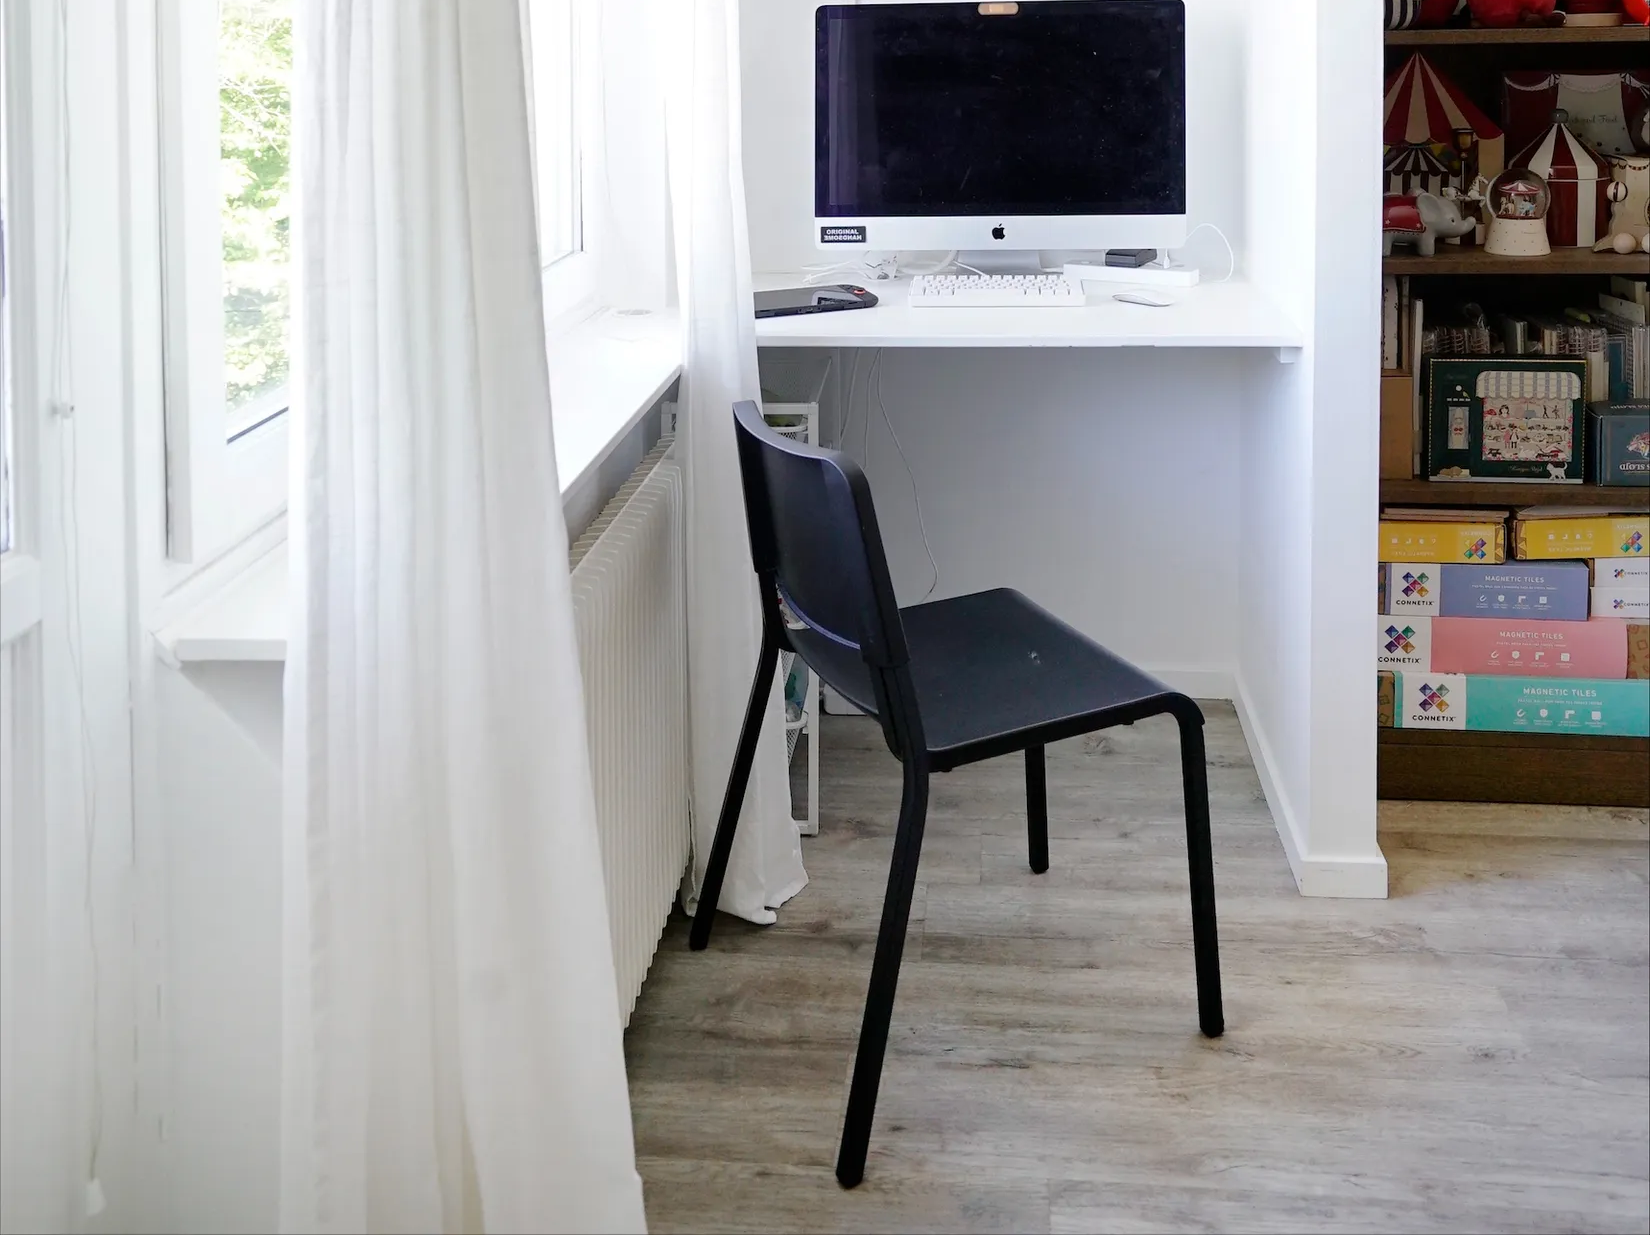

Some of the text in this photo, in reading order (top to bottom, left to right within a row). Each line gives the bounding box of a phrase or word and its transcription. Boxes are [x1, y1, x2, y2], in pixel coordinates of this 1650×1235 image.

[1484, 575, 1545, 584] MAGNETIC TILES
[1499, 631, 1564, 640] MAGNETIC TILES
[1378, 656, 1420, 664] CONNETIX
[1523, 687, 1597, 698] MAGNETIC TILES
[1412, 714, 1454, 722] CONNETIX
